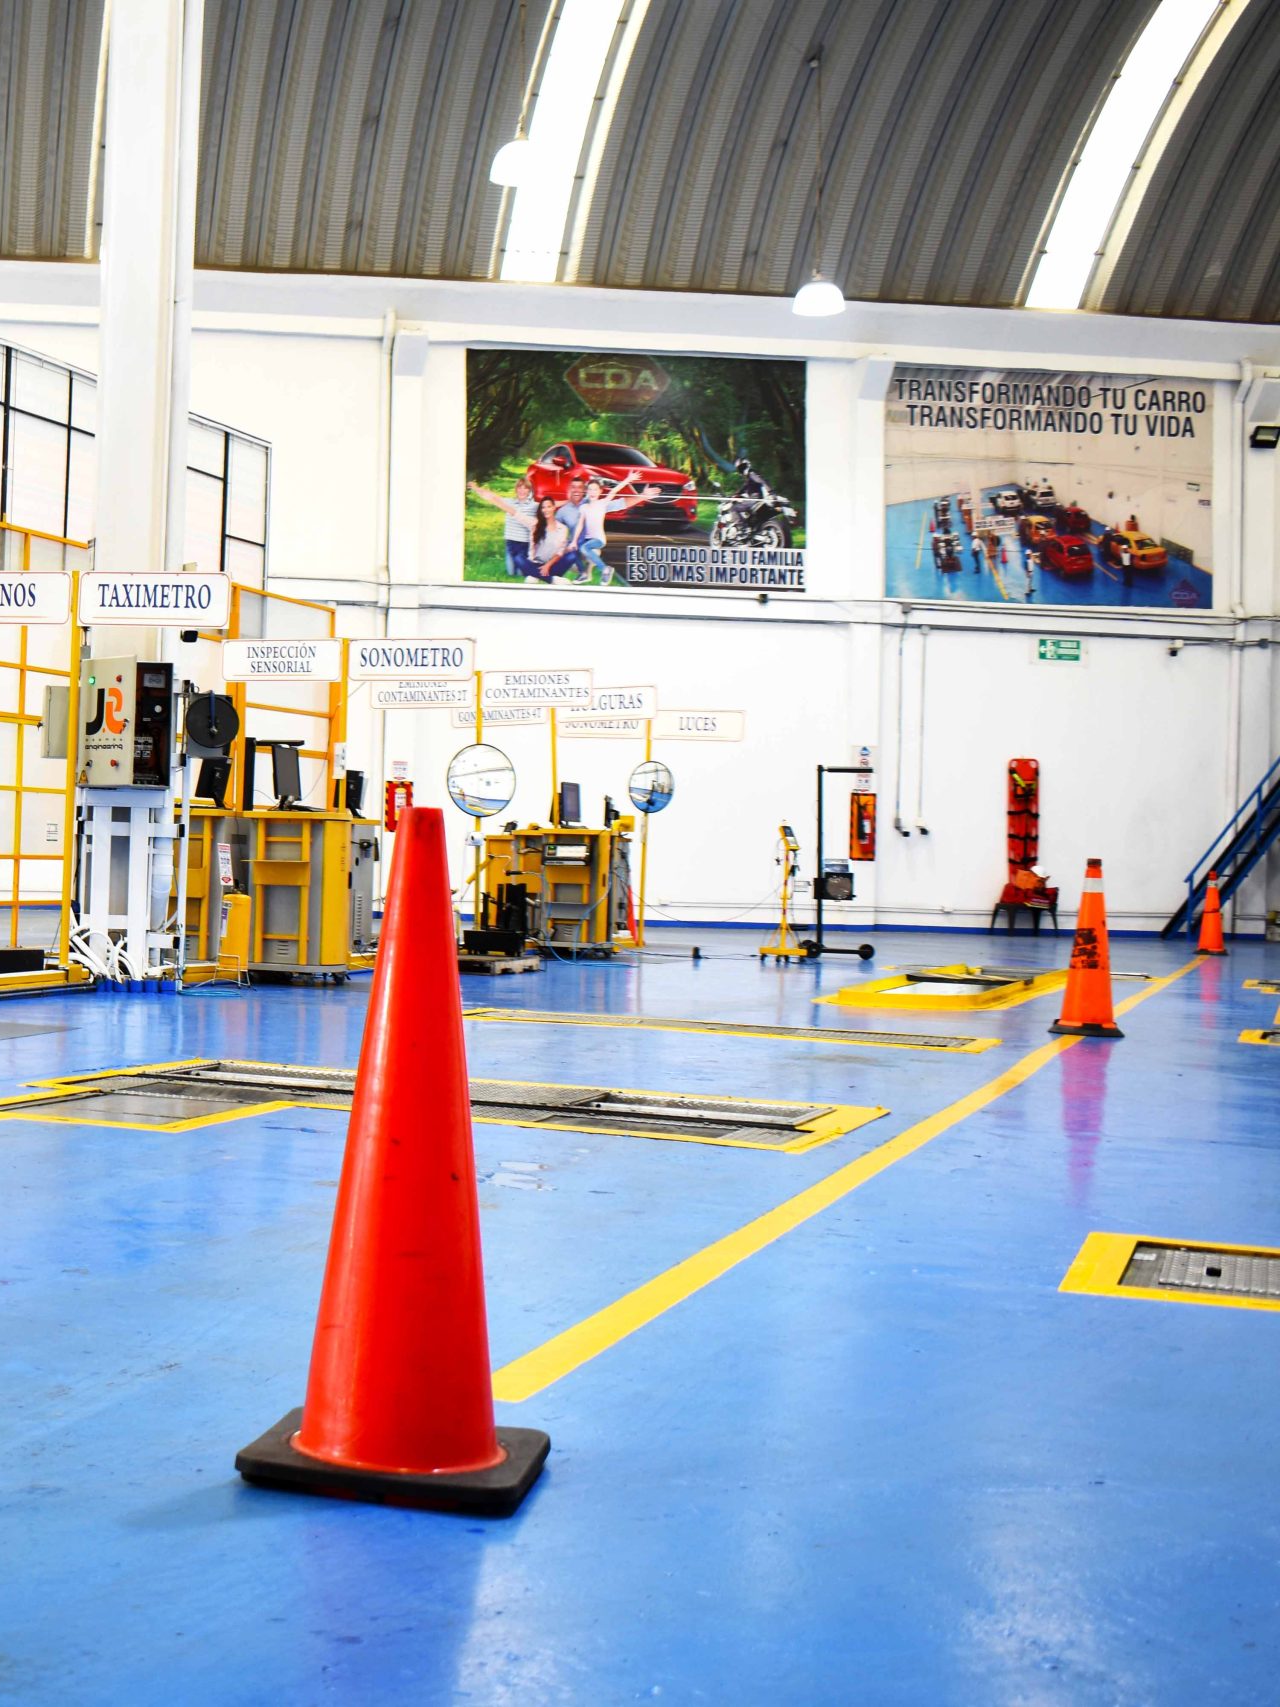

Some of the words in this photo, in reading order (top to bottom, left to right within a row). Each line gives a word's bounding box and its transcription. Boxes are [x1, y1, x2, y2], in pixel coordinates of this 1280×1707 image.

[578, 368, 659, 390] CDA
[894, 378, 1091, 409] TRANSFORMANDO
[1099, 387, 1126, 410] TU
[1134, 388, 1206, 414] CARRO
[906, 404, 1103, 435] TRANSFORMANDO
[1110, 413, 1137, 436] TU
[1145, 415, 1195, 438] VIDA
[628, 546, 643, 561] EL
[646, 546, 707, 564] CUIDADO
[711, 549, 727, 564] DE
[731, 550, 747, 565] TU
[751, 550, 804, 567] FAMILIA
[628, 564, 646, 581] ES
[650, 564, 668, 581] LO
[672, 565, 706, 583] MAS
[709, 566, 804, 586] IMPORTANTE
[98, 583, 212, 610] TAXIMETRO
[247, 642, 317, 659] INSPECCIÓN
[359, 647, 464, 668] SONOMETRO
[250, 661, 313, 674] SENSORIAL
[504, 674, 570, 686] EMISIONES
[377, 690, 456, 703] CONTAMINANTES
[485, 687, 590, 699] CONTAMINANTES
[458, 708, 531, 722] CONAMINANTES
[678, 716, 718, 732] LUCES
